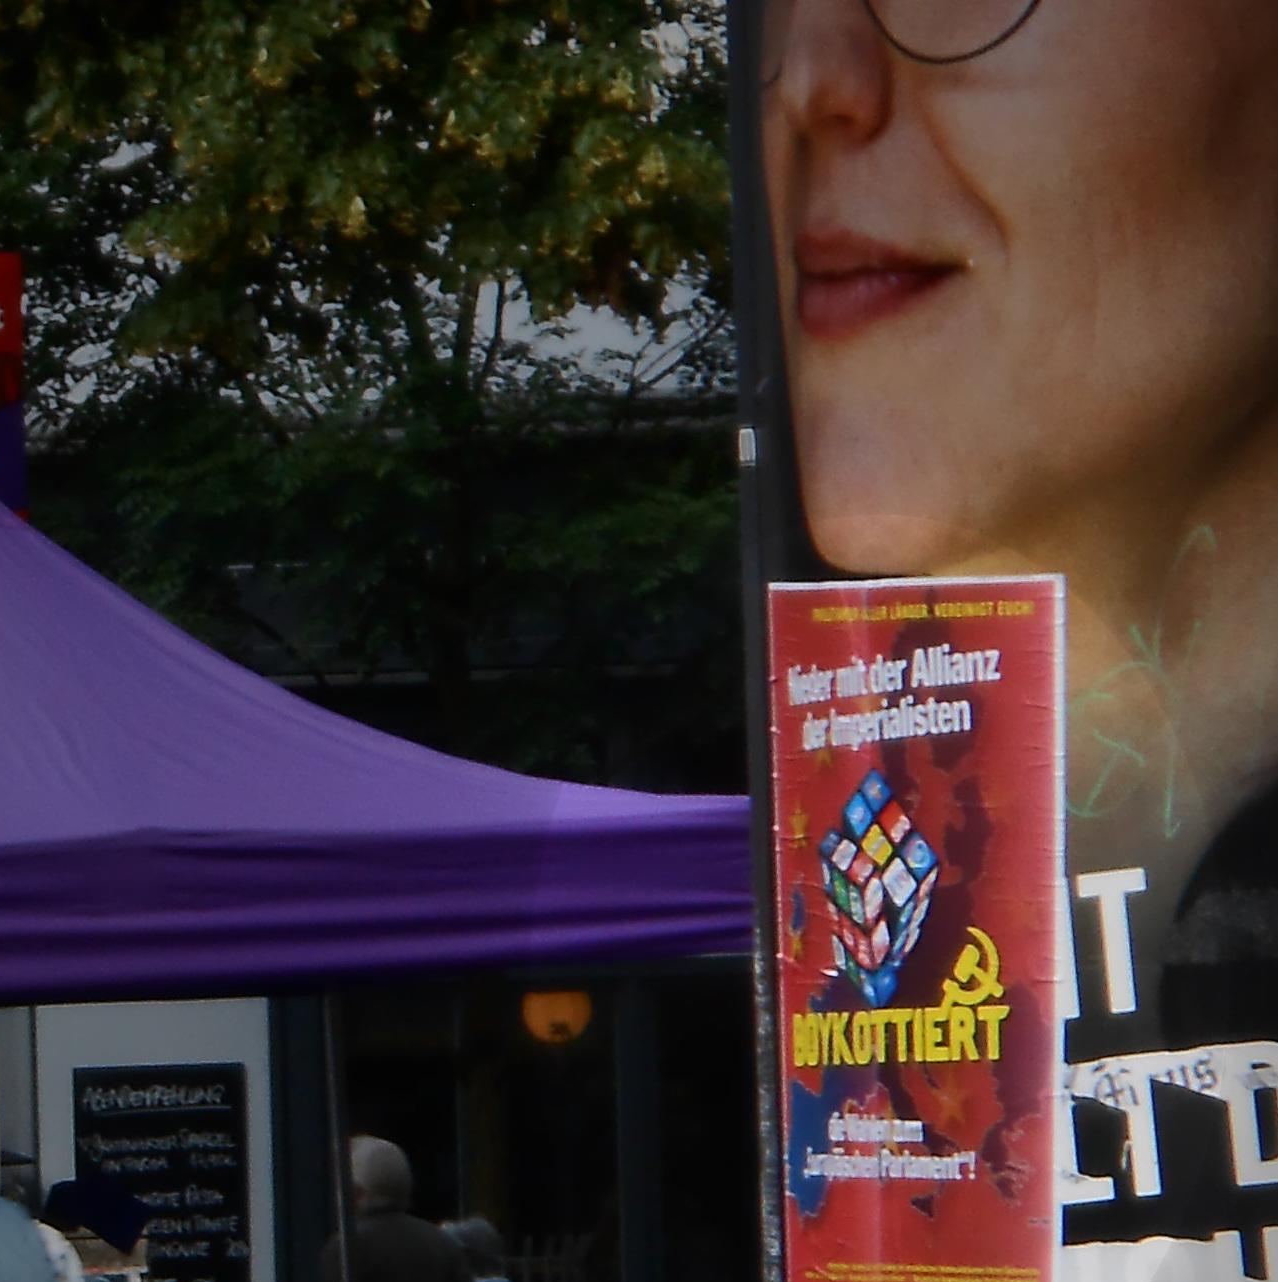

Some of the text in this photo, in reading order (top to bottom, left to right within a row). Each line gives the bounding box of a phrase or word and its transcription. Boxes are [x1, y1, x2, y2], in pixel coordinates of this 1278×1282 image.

[870, 654, 907, 694] der
[911, 643, 1001, 688] Allianz
[792, 1004, 1010, 1068] BOYKOTTIERT
